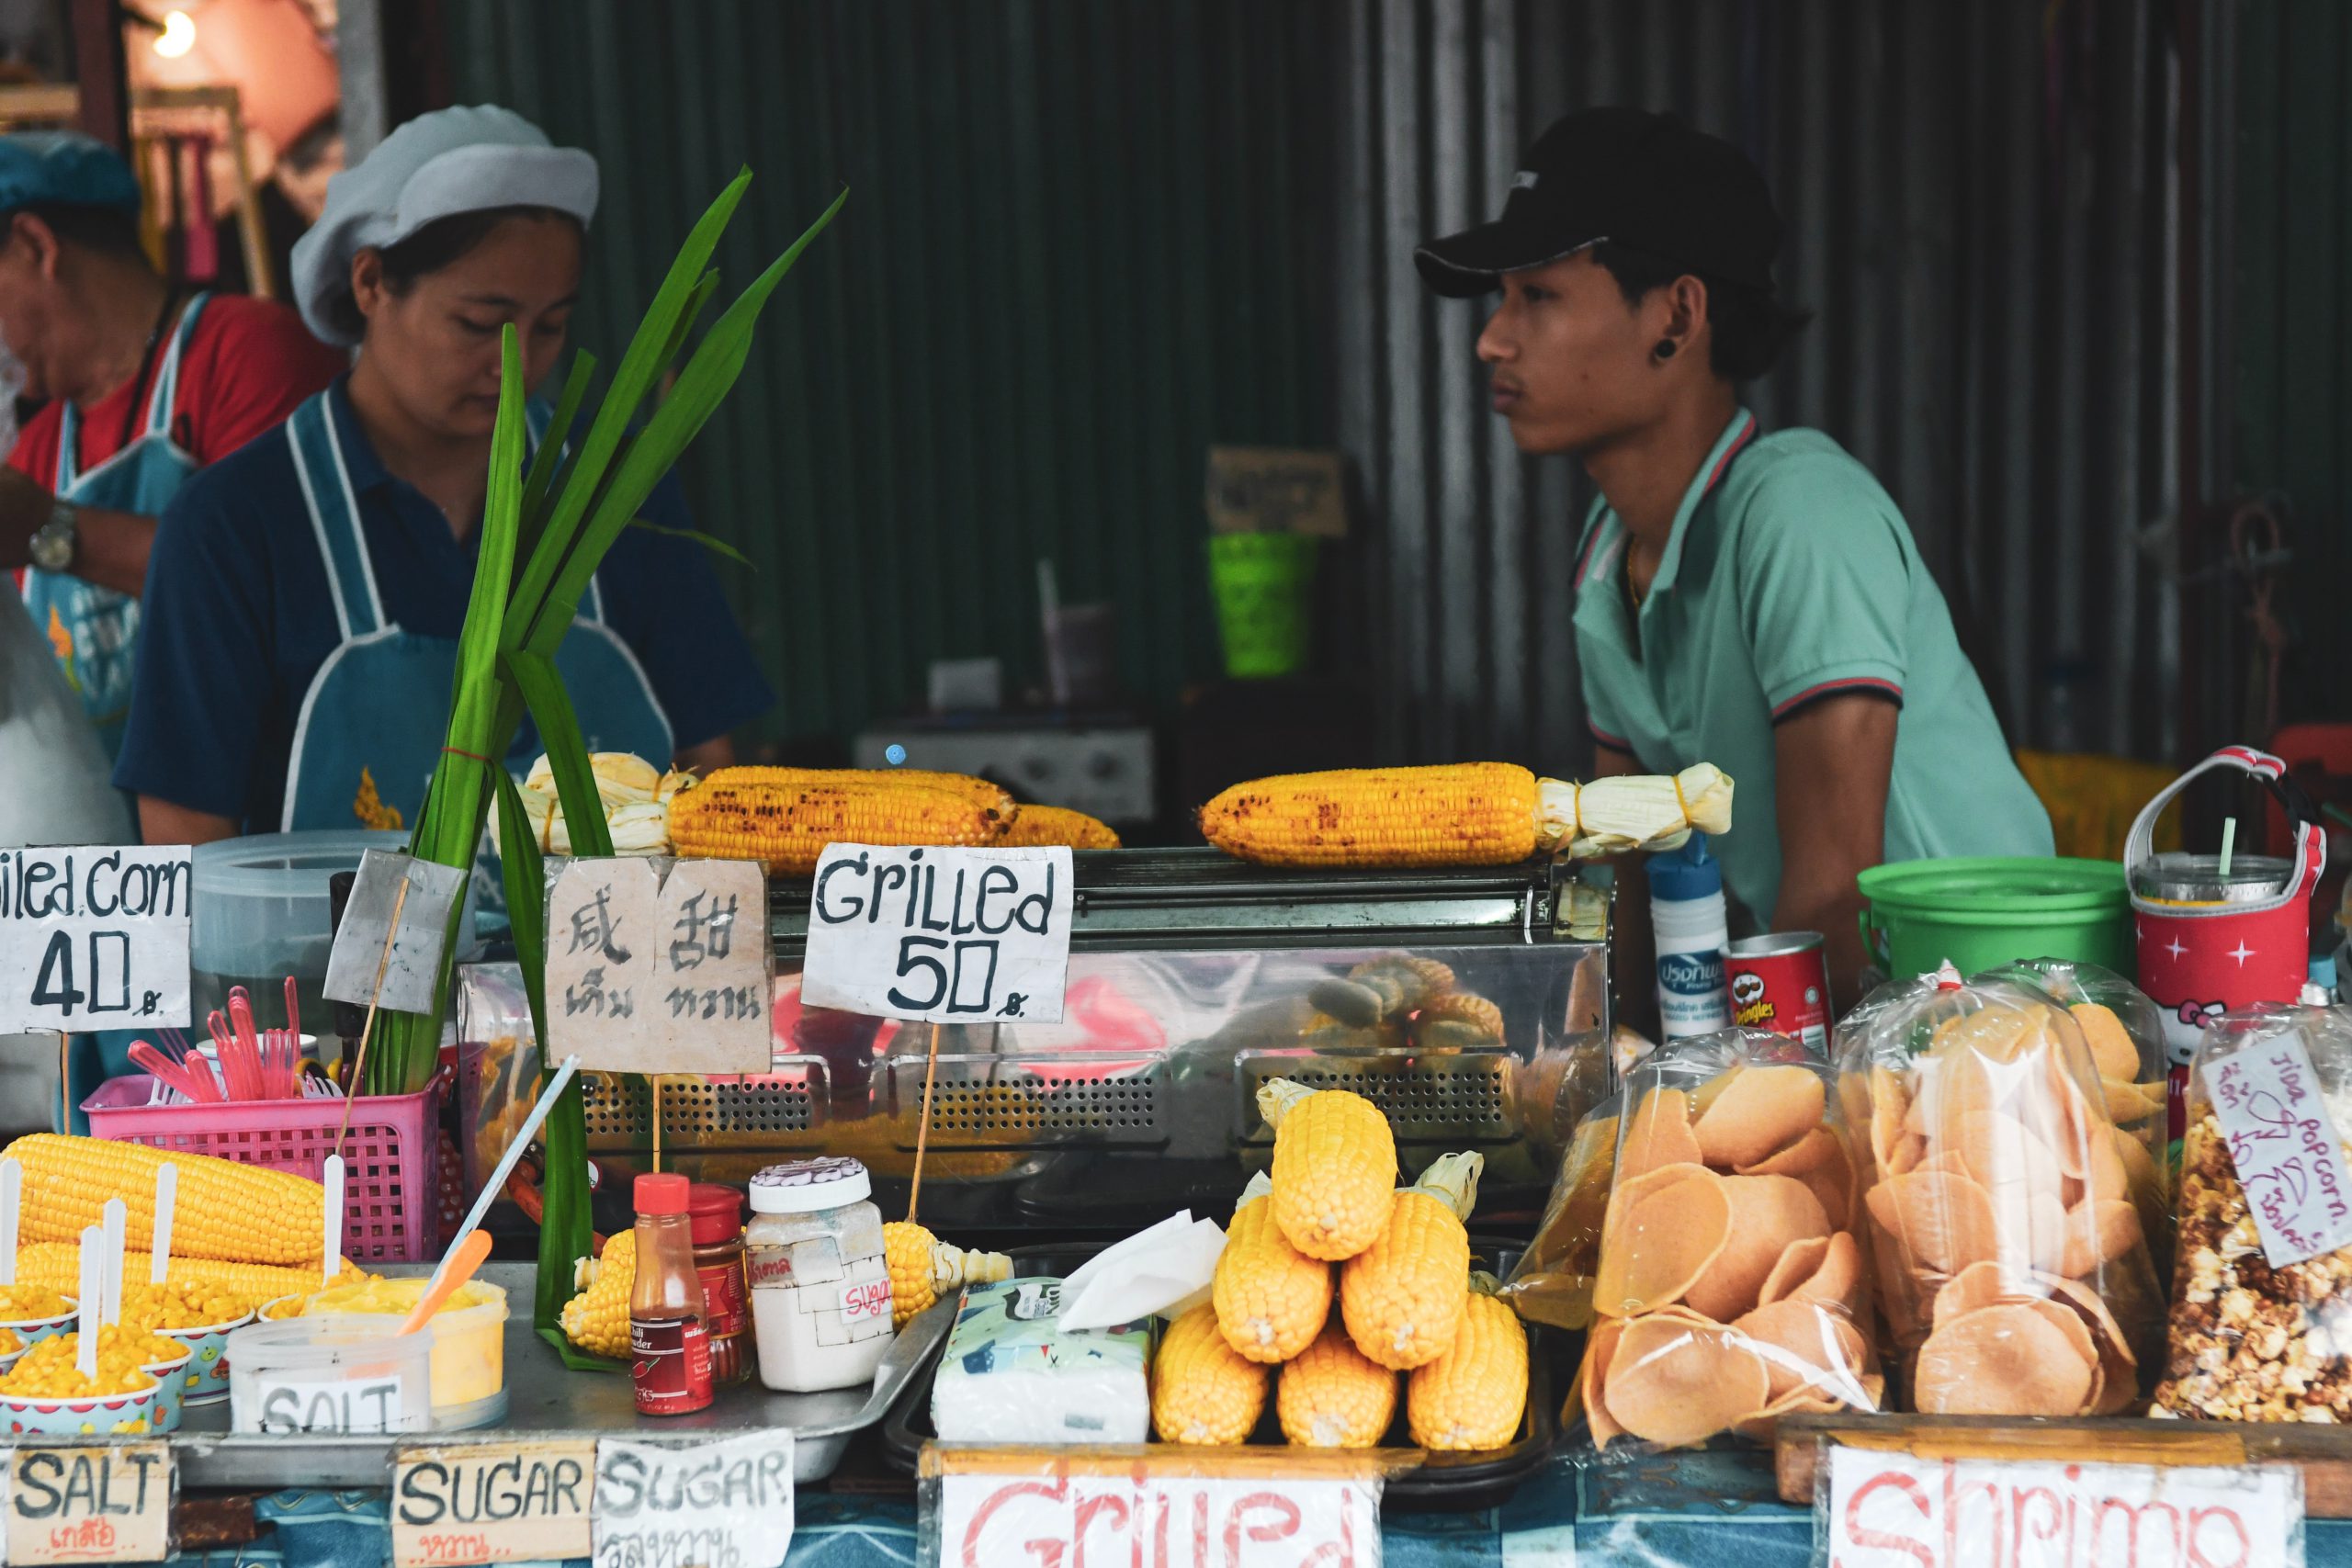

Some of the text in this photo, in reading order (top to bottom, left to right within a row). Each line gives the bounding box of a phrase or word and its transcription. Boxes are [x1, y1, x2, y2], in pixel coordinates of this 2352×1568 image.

[816, 848, 1055, 936] Grilled
[15, 1452, 160, 1518] SALT
[400, 1454, 582, 1525] SUGAR
[597, 1450, 788, 1517] SUGAR
